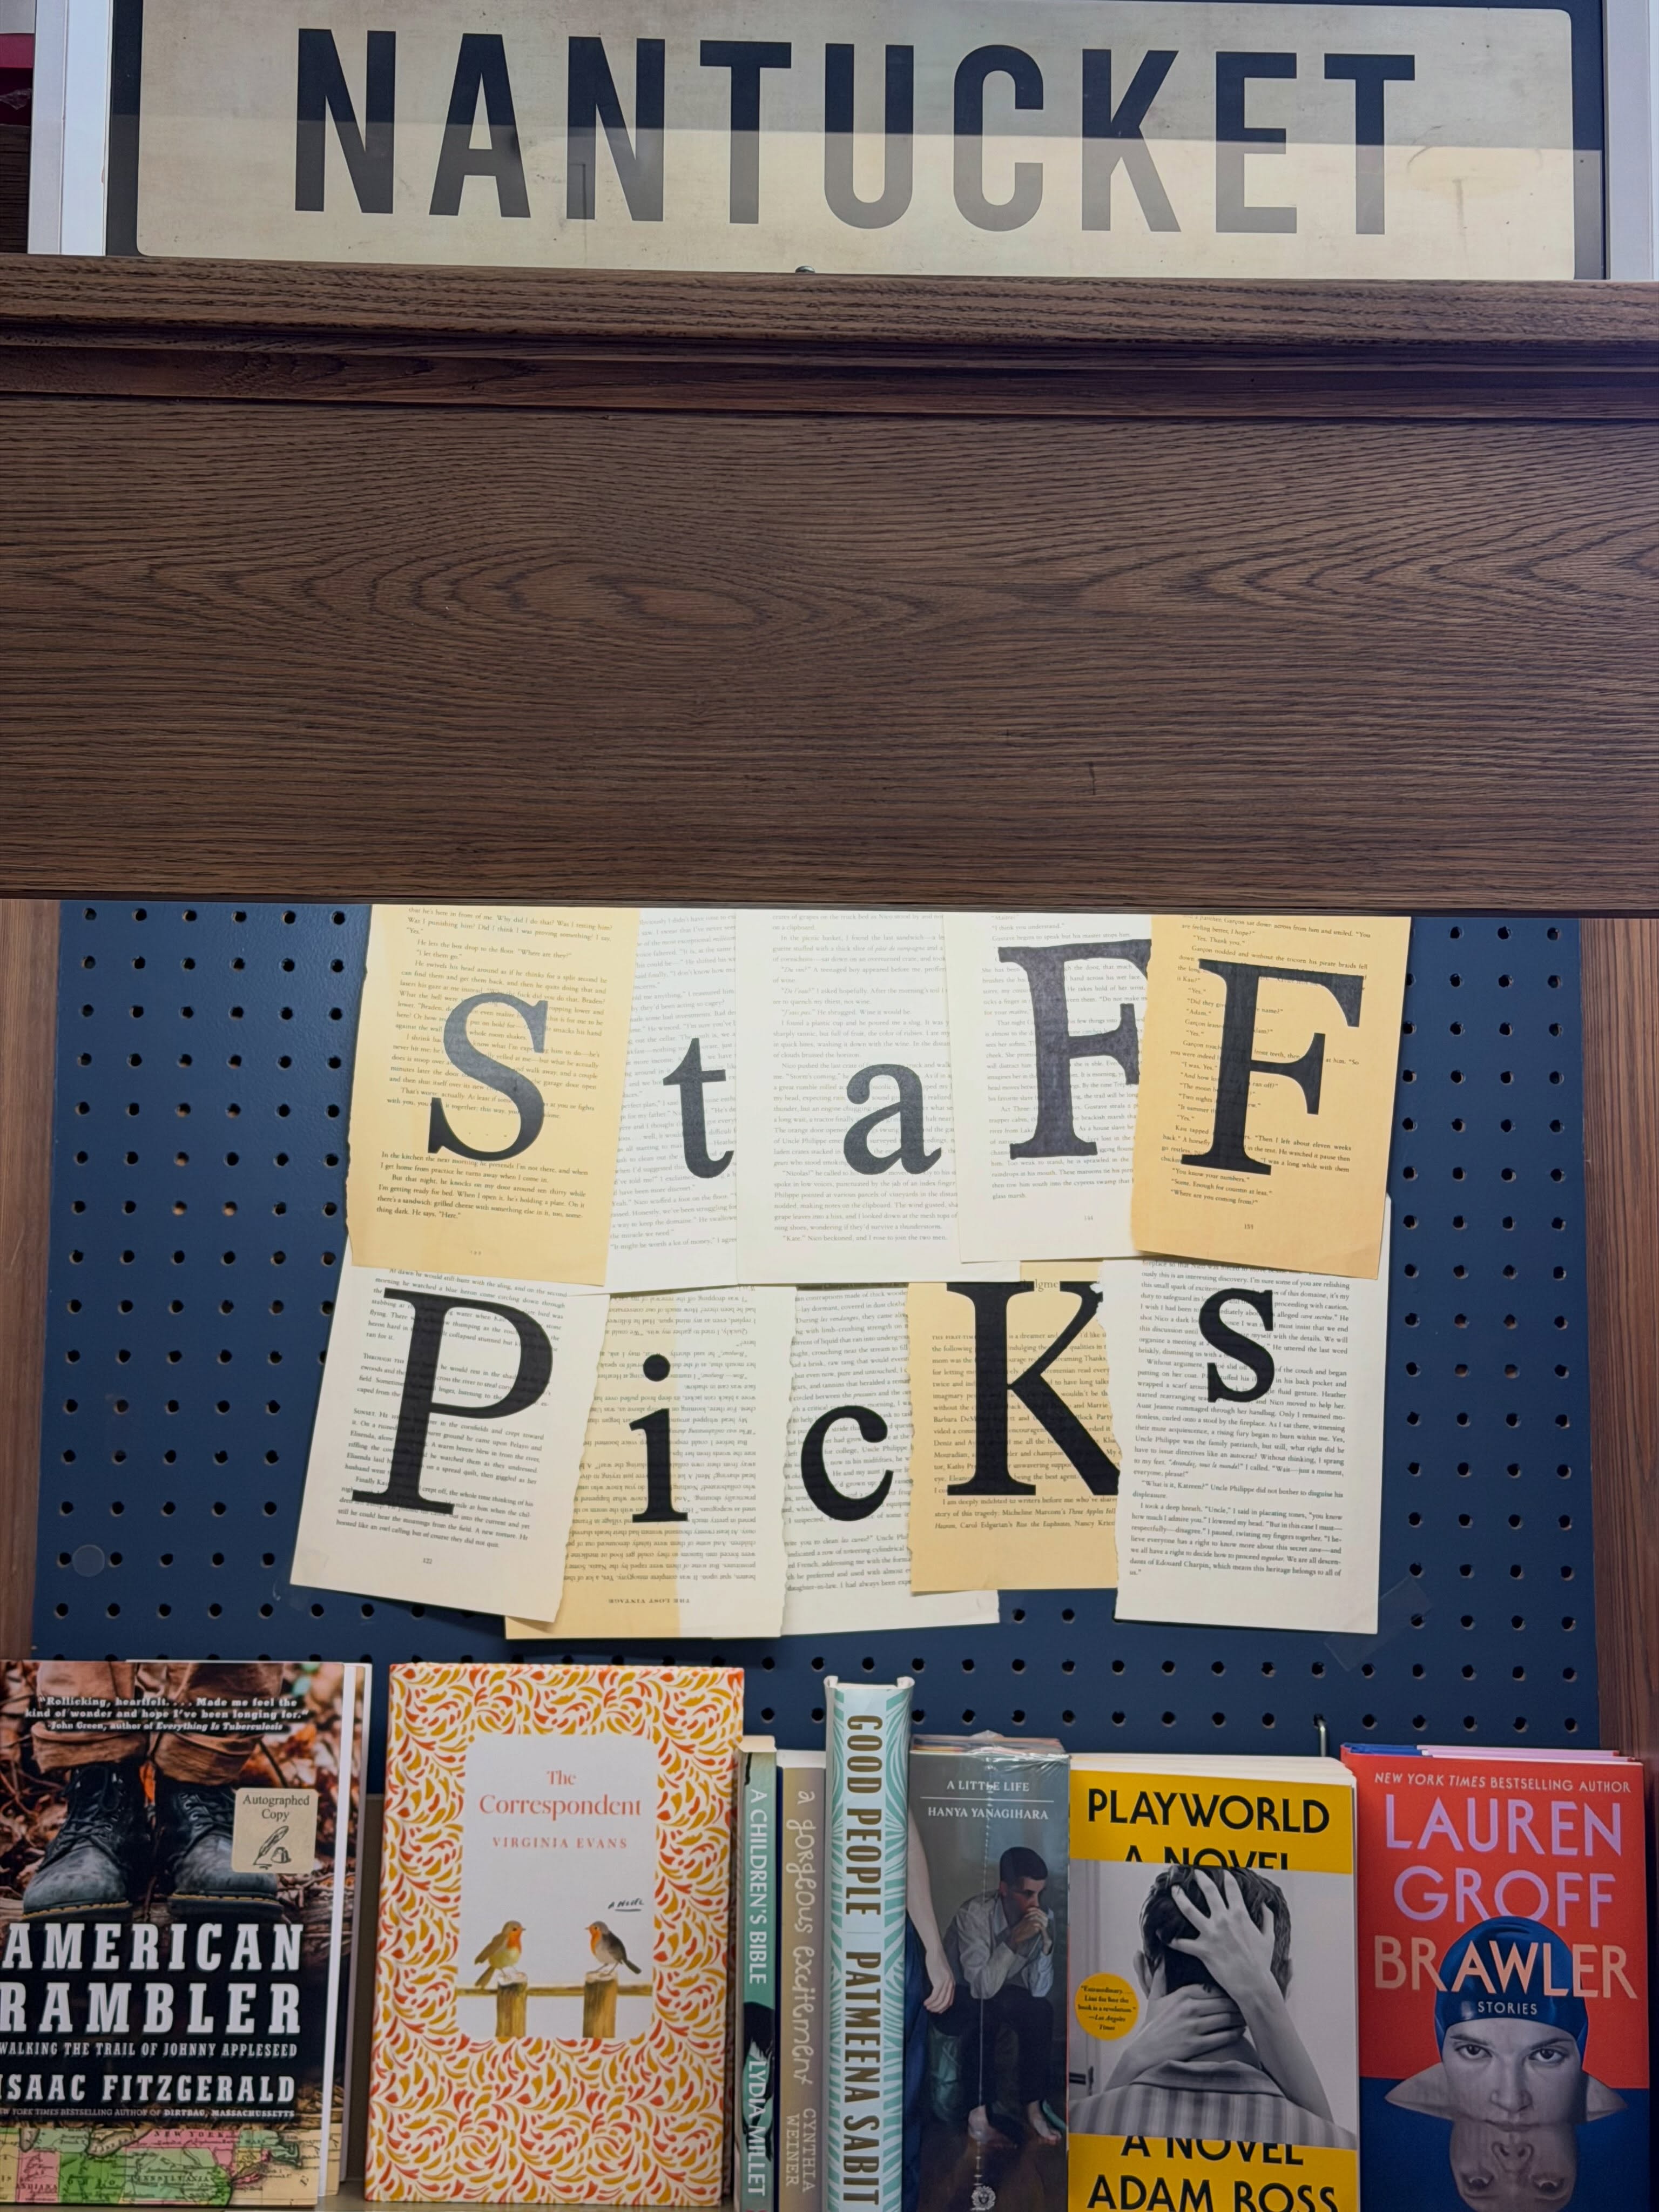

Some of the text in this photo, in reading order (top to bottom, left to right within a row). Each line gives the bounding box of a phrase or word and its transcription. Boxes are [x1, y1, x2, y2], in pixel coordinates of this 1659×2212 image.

[295, 28, 1415, 235] NANTUCKET
[547, 1770, 576, 1785] The
[947, 1781, 1030, 1791] A LITTLE LIFE
[1375, 1772, 1631, 1793] NEW YORK TIMES BESTSELLING AUTHOR
[243, 1795, 309, 1807] Autographed
[262, 1809, 289, 1822] Copy
[480, 1794, 642, 1821] Correspondent
[846, 1715, 882, 1915] GOOD PEOPLE
[928, 1807, 1048, 1820] HANYA YANAGIHARA
[1088, 1789, 1330, 1833] PLAYWORLD
[493, 1837, 628, 1849] VIRGINIA EVANS
[1385, 1793, 1622, 1857] LAUREN
[750, 1789, 767, 1984] A CHILDREN'S BIBLE
[1394, 1865, 1616, 1928] GROFF
[2, 1923, 304, 1971] AMERICAN
[1374, 1935, 1638, 1999] BRAWLER
[0, 1982, 301, 2034] RAMBLER
[1478, 2001, 1538, 2015] STORIES
[0, 2042, 297, 2056] WALKING THE TRAIL OF JOHNNY APPLESEED
[102, 2075, 295, 2102] FITZGERALD
[843, 1952, 881, 2206] PATMEENA SABIT
[747, 2060, 766, 2196] LYDIA MILLET
[786, 2114, 800, 2187] WEINER
[802, 2108, 816, 2193] CYNTHIA
[1121, 2135, 1303, 2165] A NOVEL
[1087, 2175, 1338, 2212] ADAM ROSS
